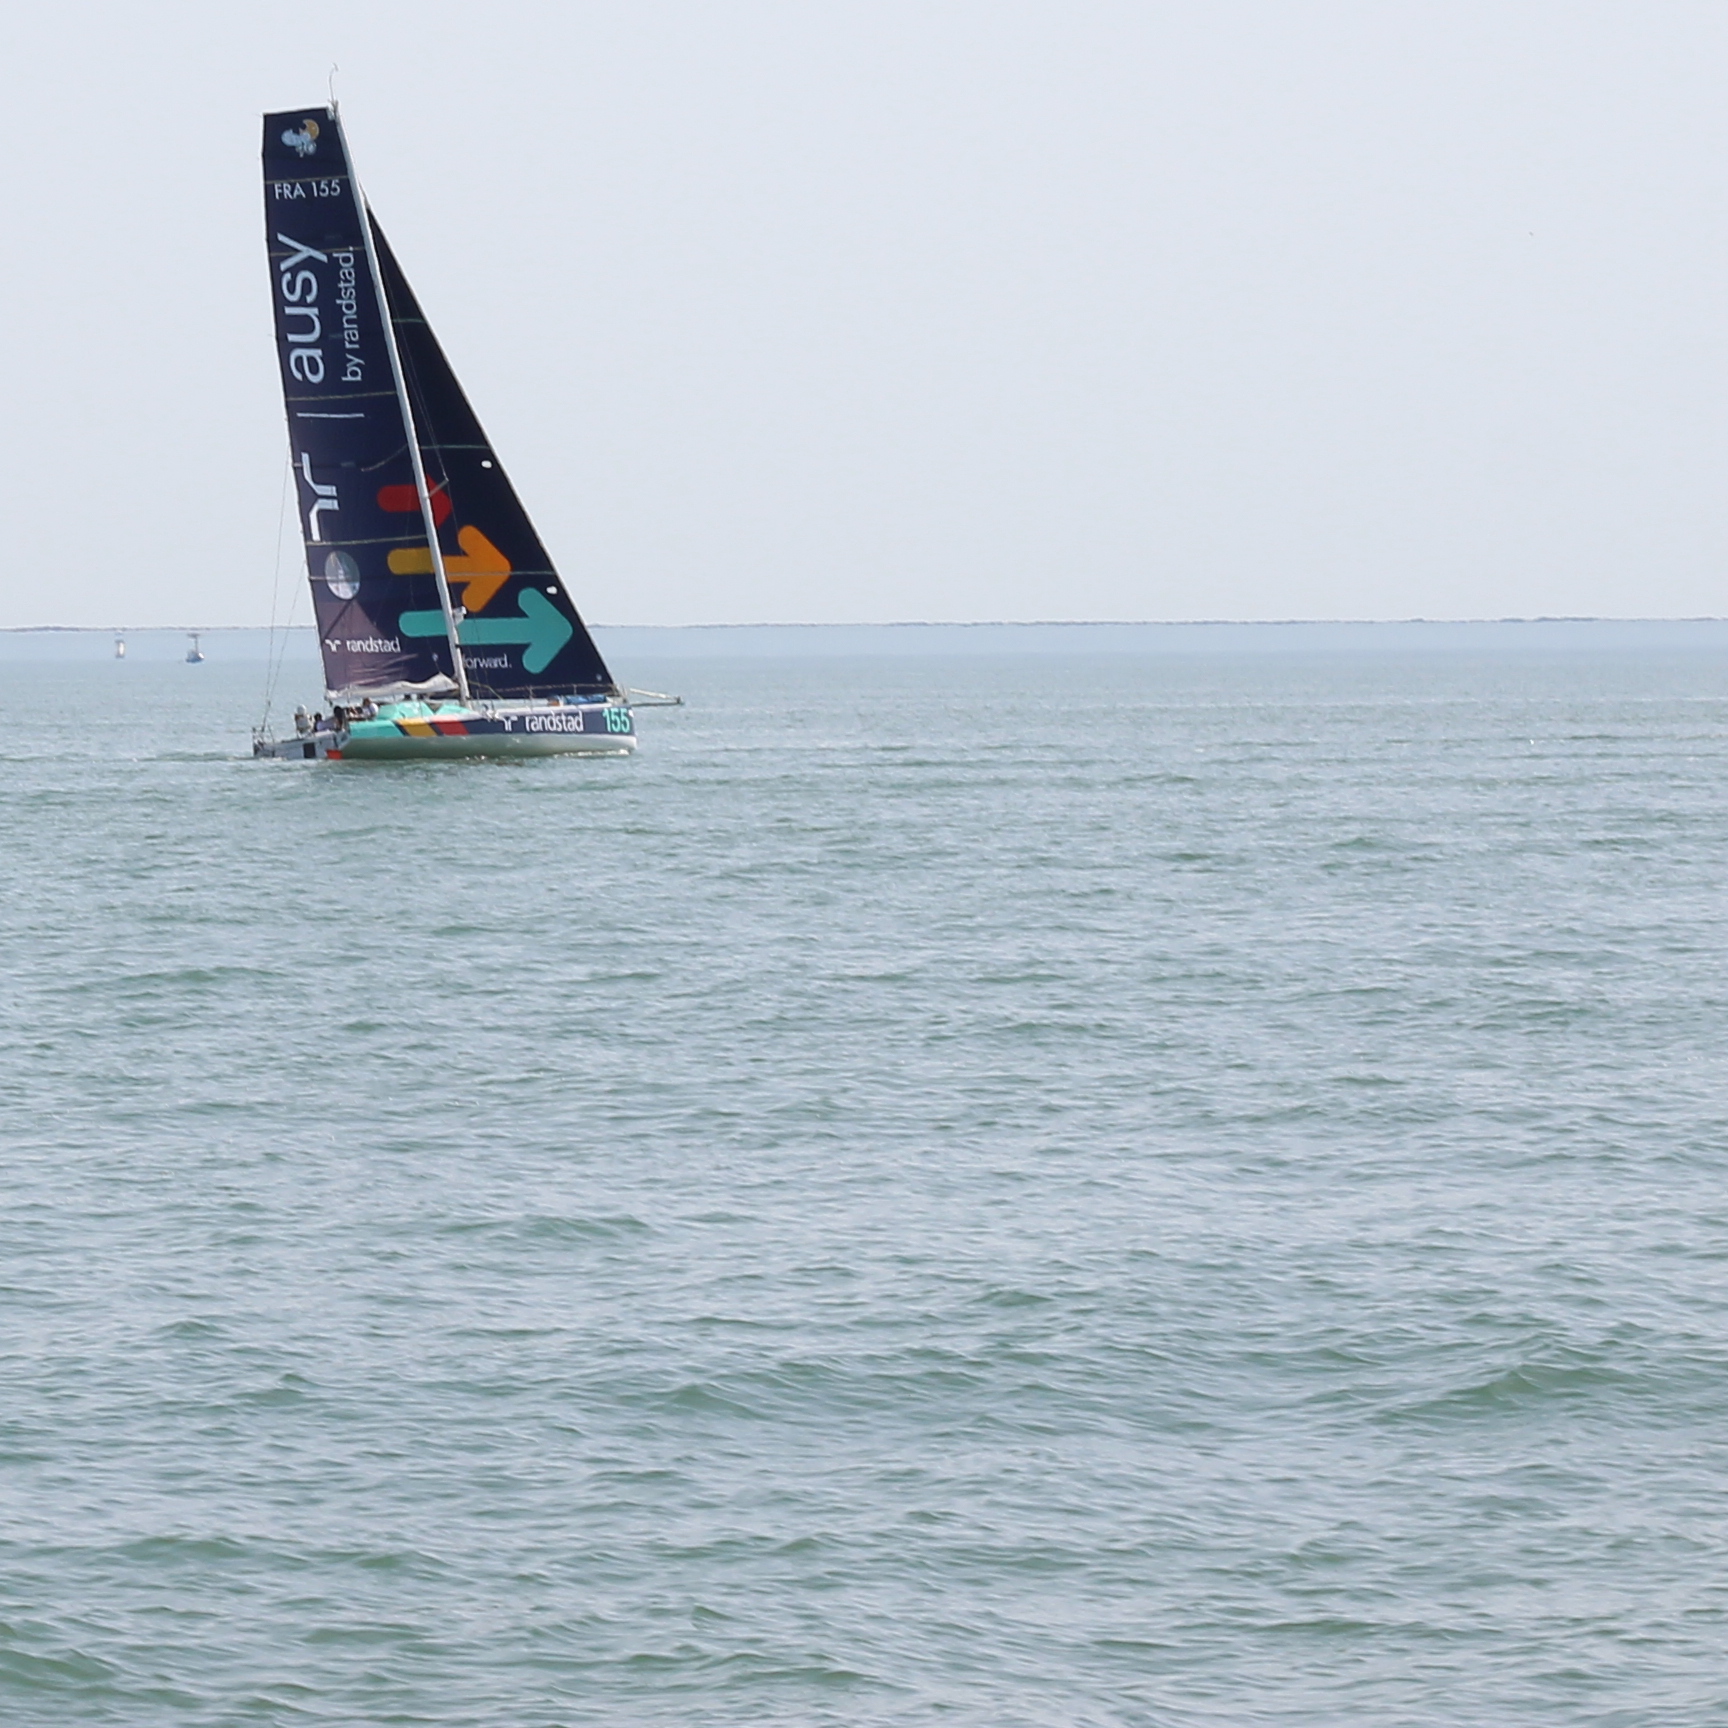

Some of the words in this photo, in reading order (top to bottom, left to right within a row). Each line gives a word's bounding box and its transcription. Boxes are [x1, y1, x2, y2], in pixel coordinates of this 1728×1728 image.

[274, 182, 307, 200] FRA
[311, 179, 341, 197] 155
[277, 232, 329, 385] ausy
[341, 354, 366, 382] by
[346, 636, 401, 653] randstad
[525, 711, 585, 733] randstad
[602, 708, 631, 733] 155
